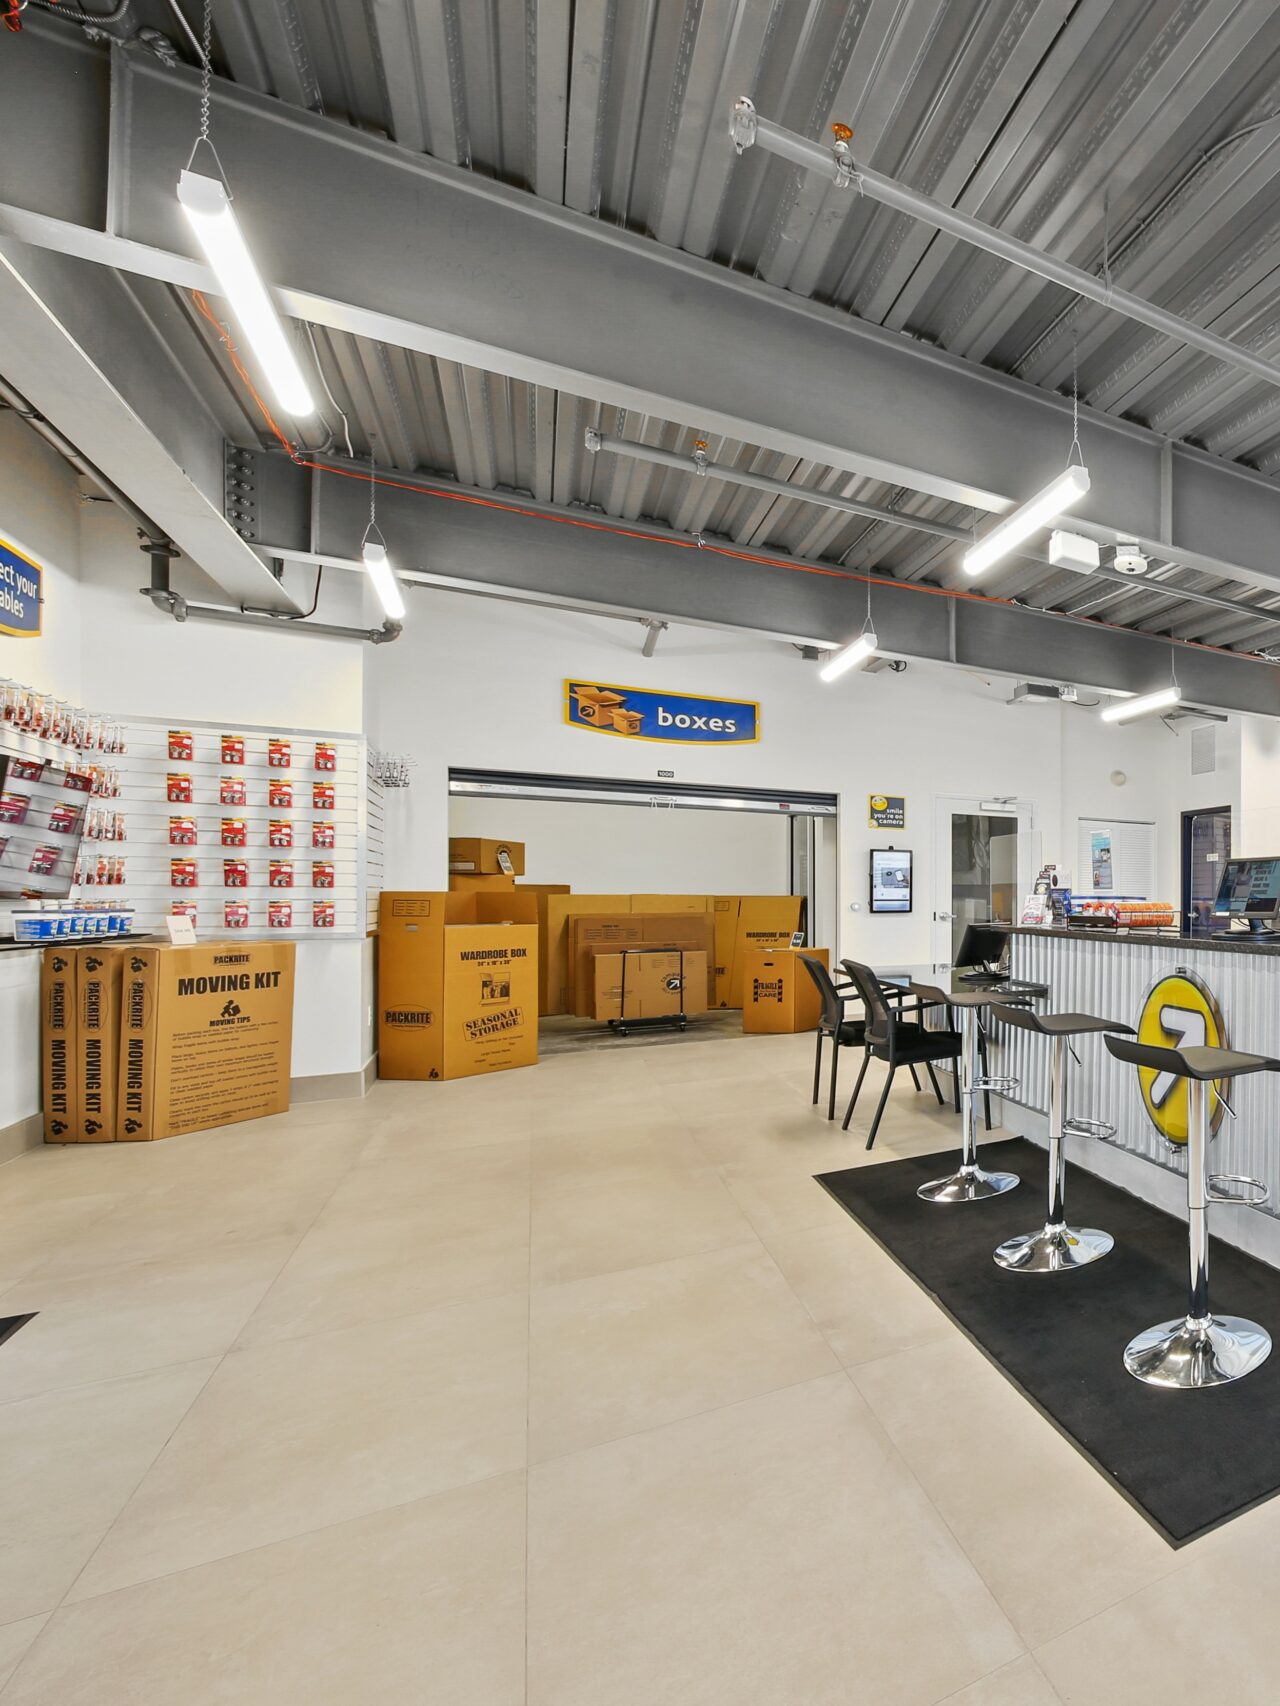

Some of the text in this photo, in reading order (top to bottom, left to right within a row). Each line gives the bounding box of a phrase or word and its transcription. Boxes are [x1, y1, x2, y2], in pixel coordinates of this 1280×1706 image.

[16, 573, 37, 599] your
[658, 706, 736, 733] boxes
[213, 954, 251, 964] PACKRITE
[460, 948, 527, 961] WARDROBE BOX
[178, 971, 281, 996] MOVING KIT
[53, 982, 65, 1028] PACKRITE
[87, 982, 100, 1028] PACKRITE
[131, 982, 144, 1029] PACKRITE
[385, 1011, 431, 1024] PACKRITE
[209, 1018, 236, 1027] MOVING
[465, 1008, 521, 1031] SEASONAL
[470, 1018, 519, 1039] STORAGE
[51, 1039, 67, 1114] MOVING KIT
[85, 1039, 101, 1113] MOVING KIT
[126, 1039, 143, 1113] MOVING KIT
